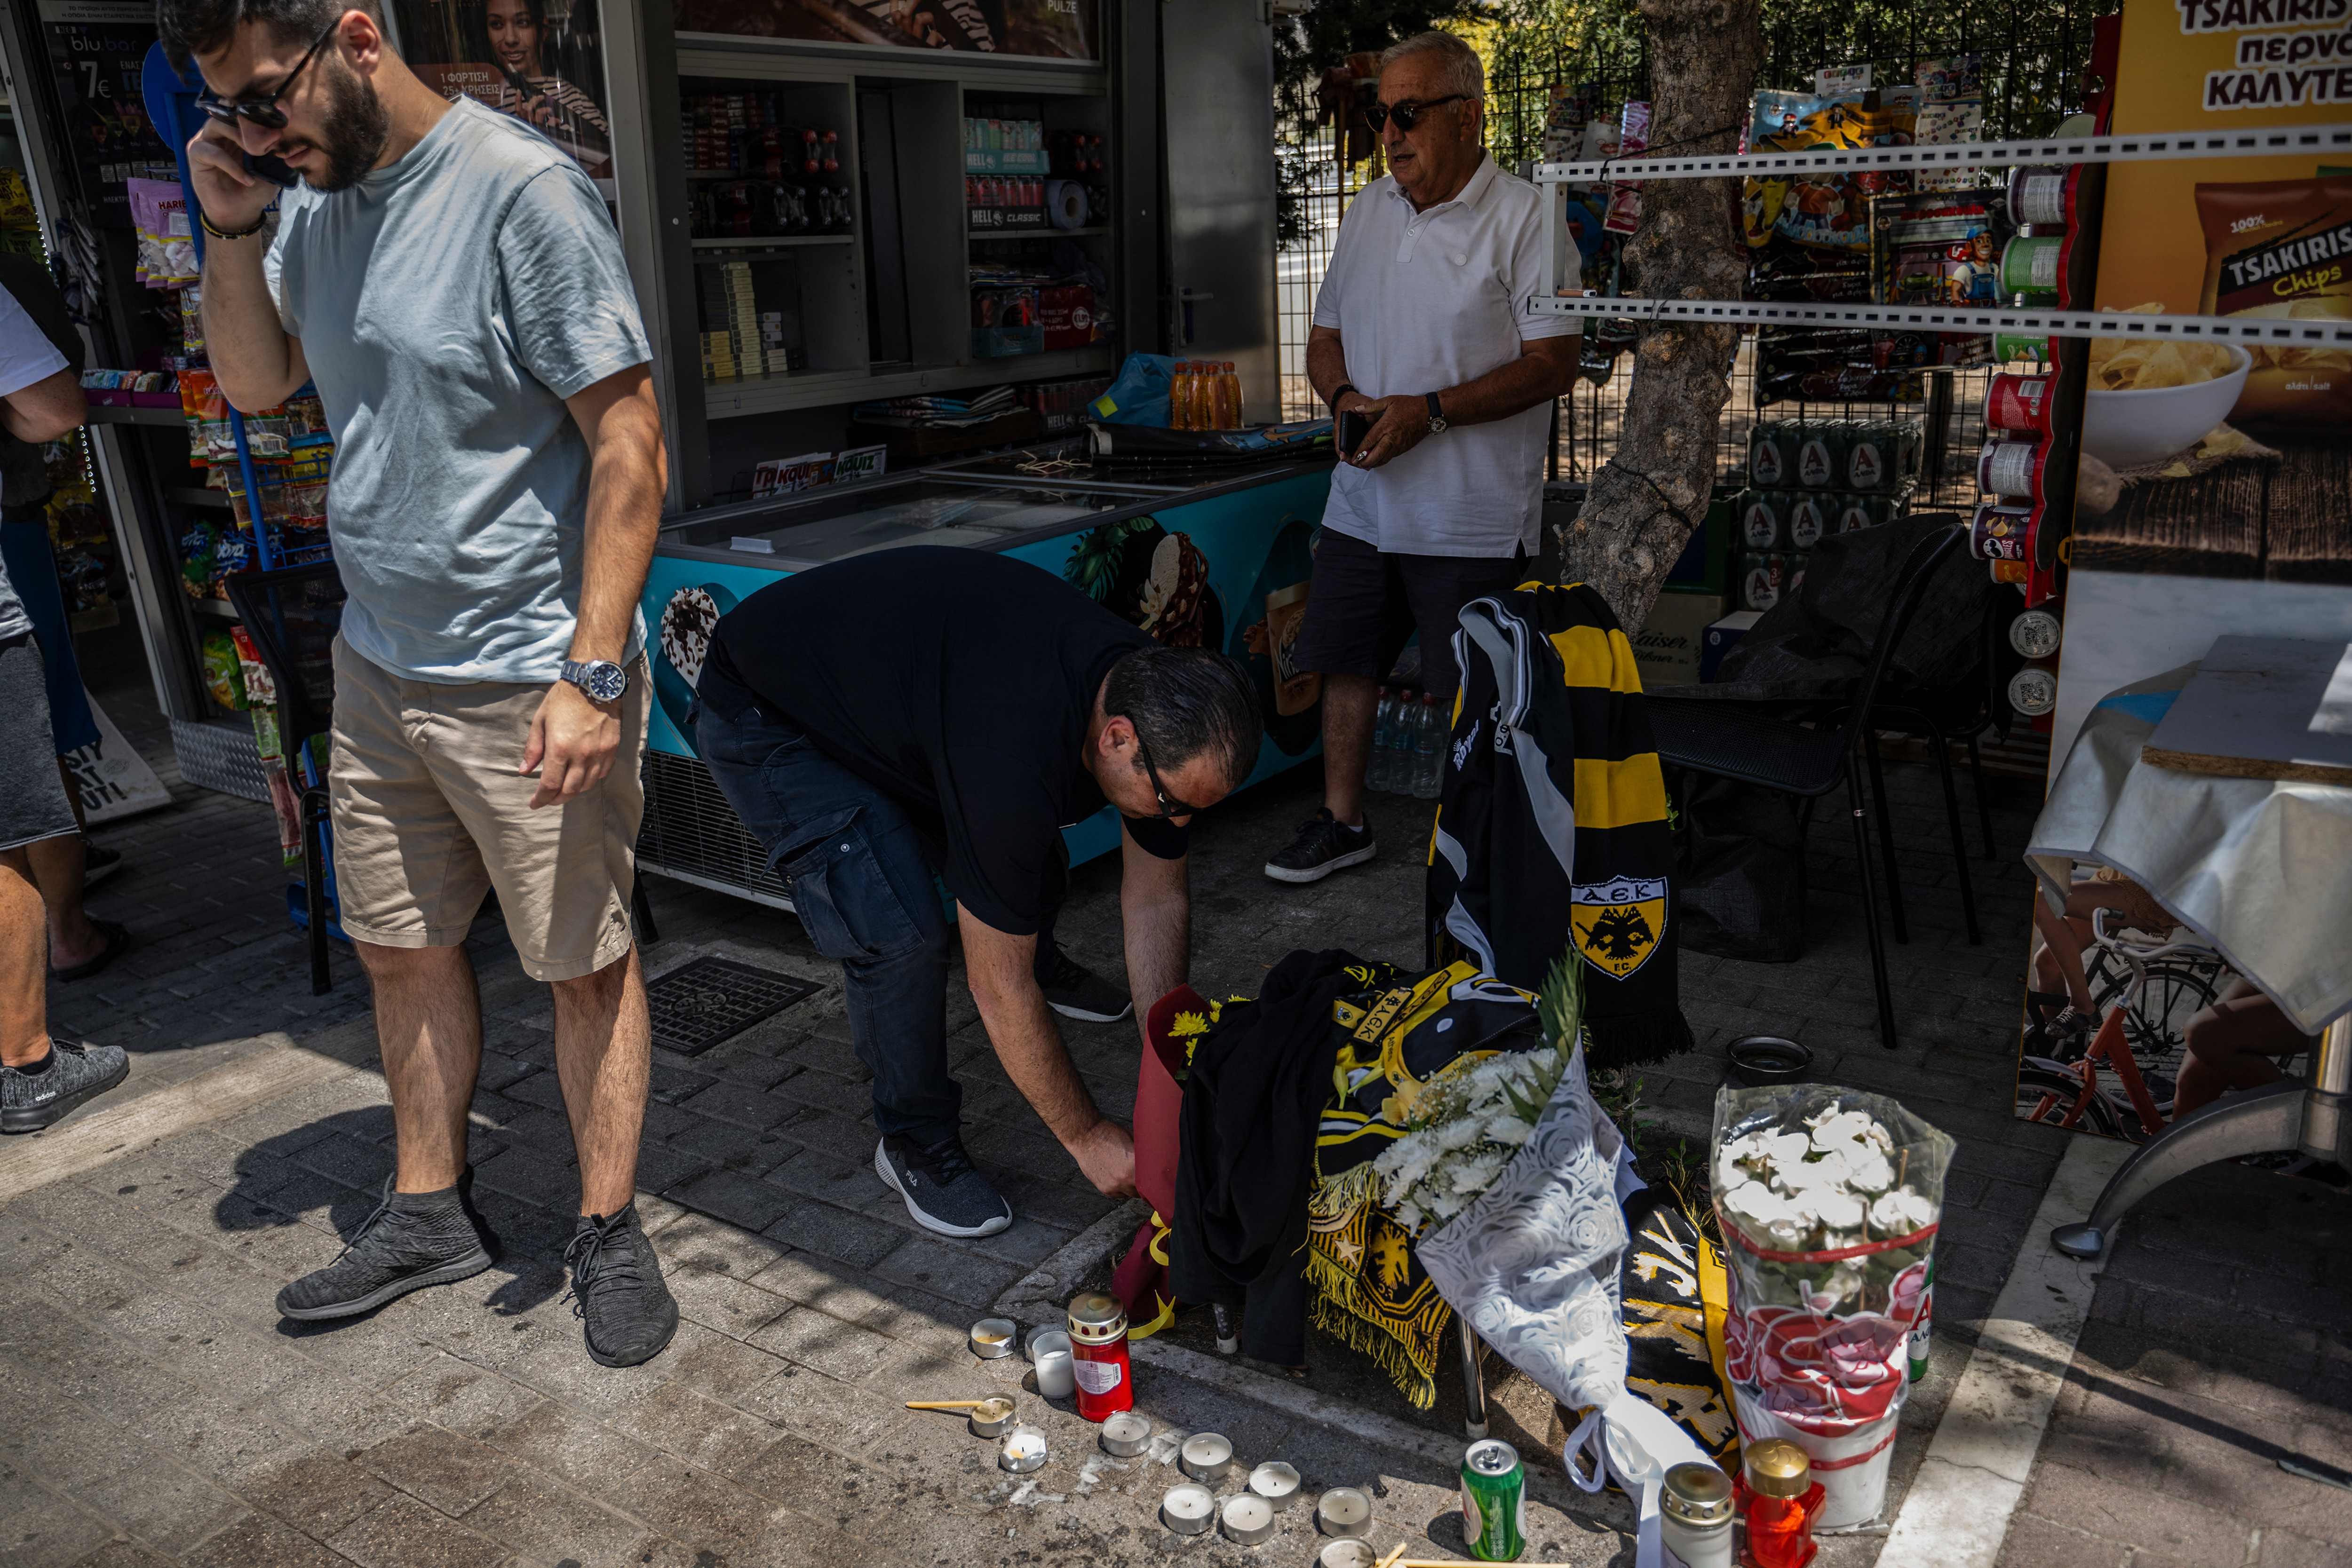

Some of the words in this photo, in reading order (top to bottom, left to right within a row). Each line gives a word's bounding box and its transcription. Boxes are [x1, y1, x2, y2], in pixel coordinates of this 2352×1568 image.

[1048, 0, 1077, 14] PULZE
[440, 73, 445, 83] 1
[447, 71, 489, 83] ΦΟΡΤΙΣΗ
[461, 84, 500, 95] ΧΡΗΣΕΙΣ
[967, 153, 985, 166] HELL
[972, 210, 993, 223] HELL
[1006, 213, 1041, 222] CLASSIC
[2228, 226, 2352, 286] TSAKIRIS
[2273, 264, 2343, 296] Chips
[1634, 629, 1689, 649] aiser
[35, 1091, 56, 1102] adidas
[906, 1170, 917, 1187] FILA
